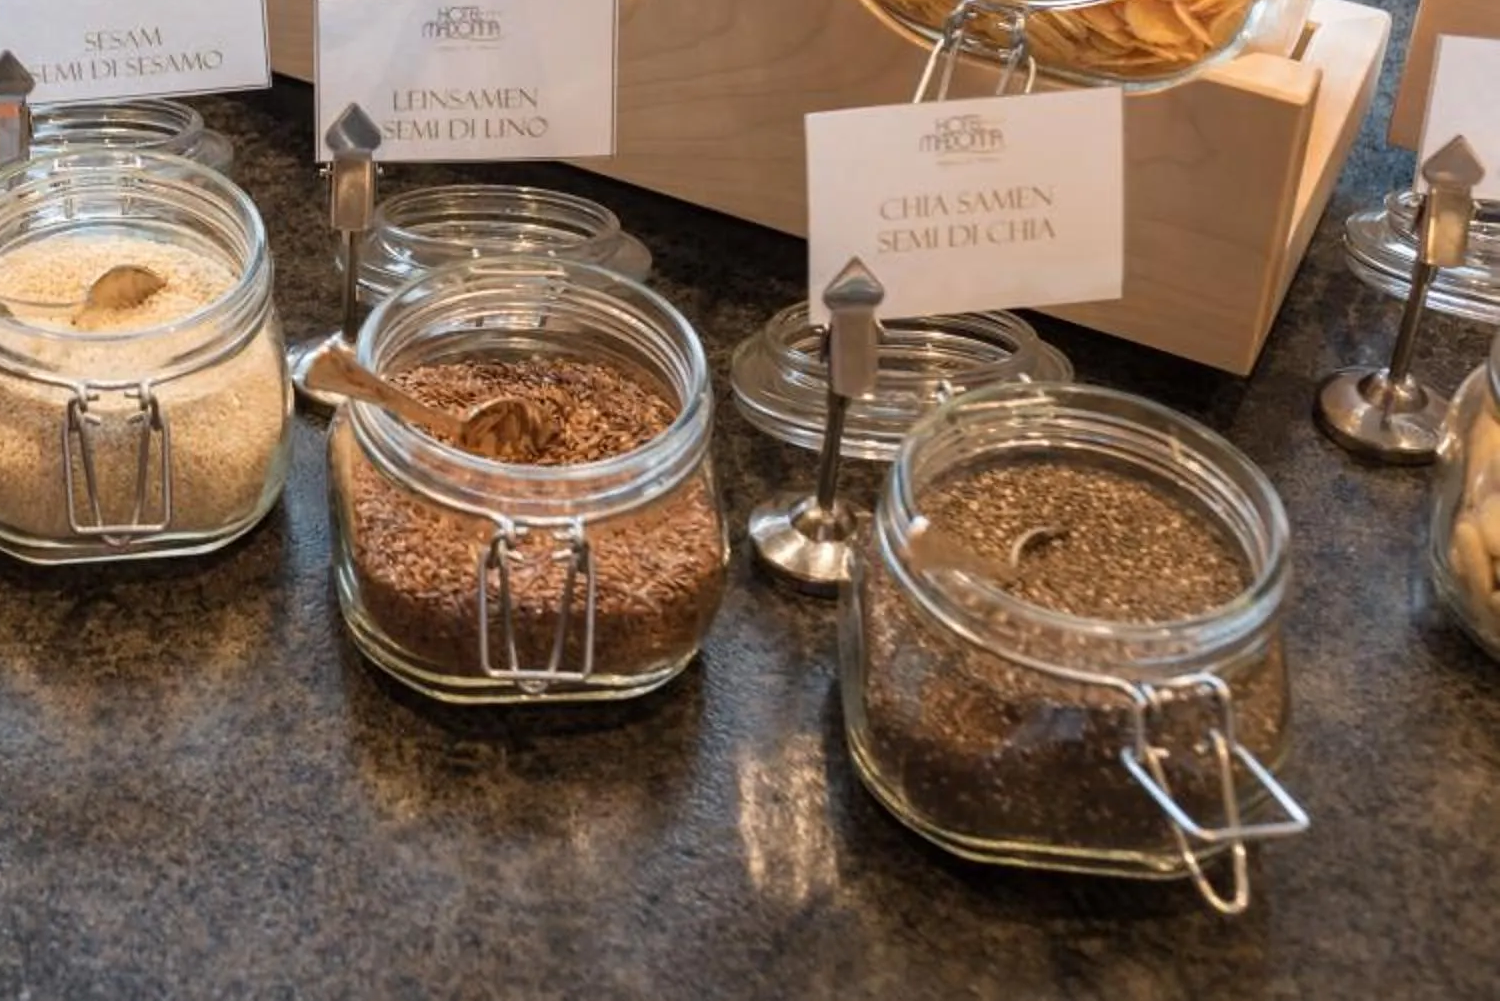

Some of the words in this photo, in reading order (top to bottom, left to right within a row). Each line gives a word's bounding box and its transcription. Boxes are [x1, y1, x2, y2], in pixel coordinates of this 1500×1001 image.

[84, 26, 164, 51] SESAM
[31, 62, 84, 85] SEMI
[91, 59, 118, 80] DI
[125, 49, 224, 77] SESAMO
[393, 87, 538, 111] LEINSAMEN
[383, 119, 440, 141] SEMI
[449, 118, 477, 140] DI
[484, 116, 550, 139] LINO
[879, 194, 949, 221] CHIA
[957, 185, 1054, 215] SAMEN
[877, 226, 938, 253] SEMI
[948, 224, 978, 248] DI
[986, 218, 1057, 246] CHIA
